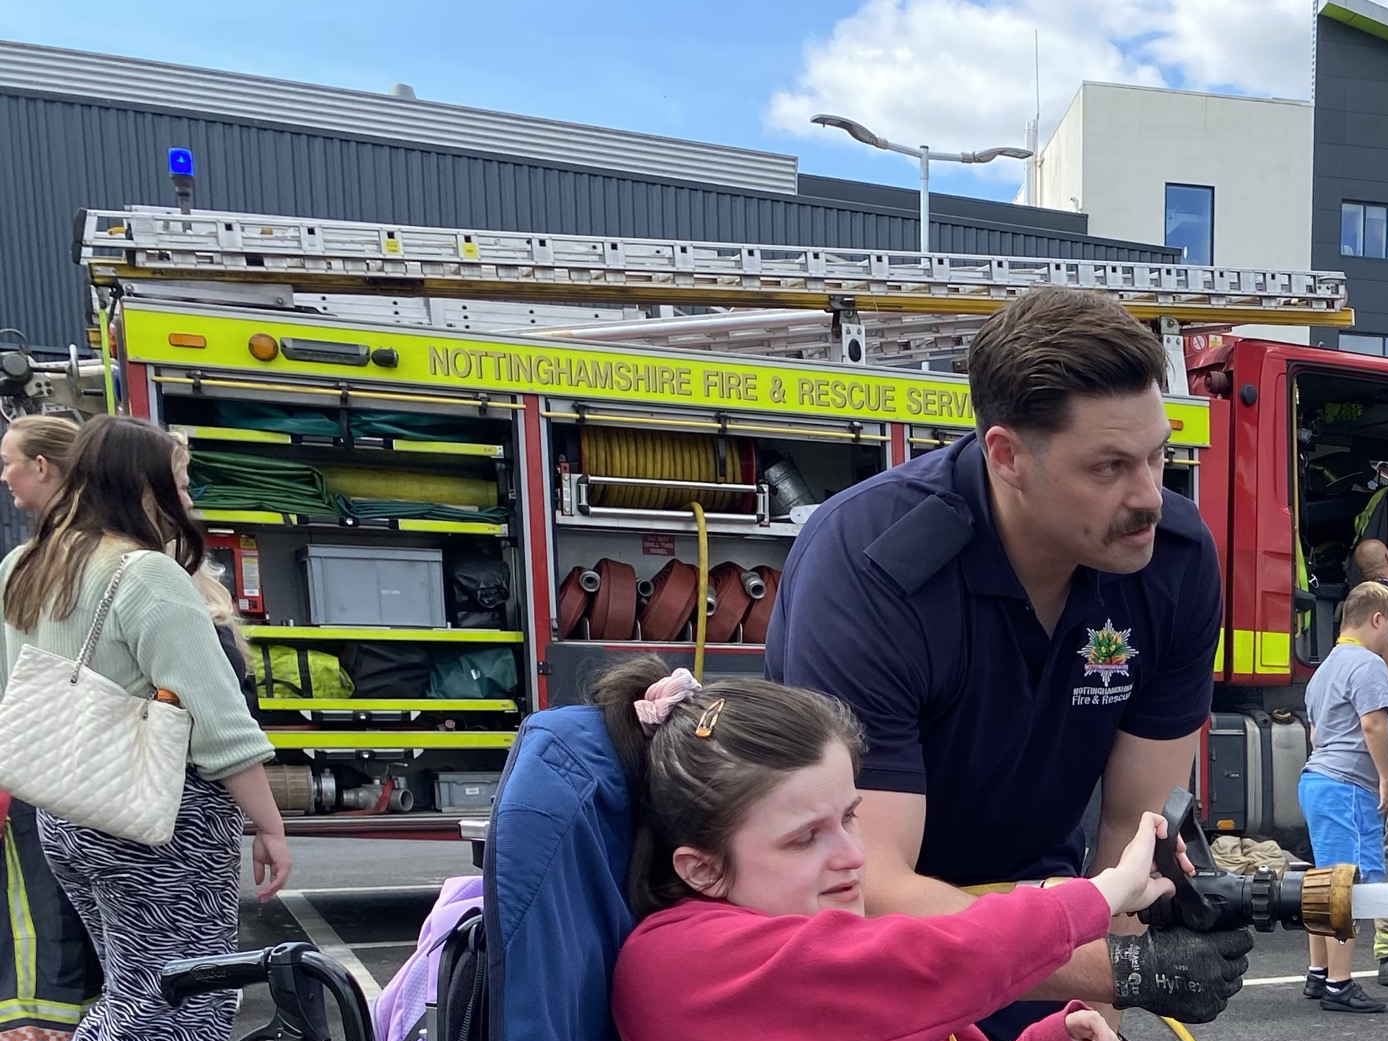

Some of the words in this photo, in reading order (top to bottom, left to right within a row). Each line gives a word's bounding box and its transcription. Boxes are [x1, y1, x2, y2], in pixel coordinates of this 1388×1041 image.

[428, 346, 692, 396] NOTTINGHAMSHIRE
[703, 370, 758, 401] FIRE
[769, 375, 787, 404] &
[798, 378, 896, 412] RESCUE
[906, 387, 973, 418] SERVI
[1072, 695, 1091, 706] Fire
[1092, 695, 1100, 705] &
[1102, 691, 1132, 705] Rescue
[1155, 973, 1205, 994] HyFlex
